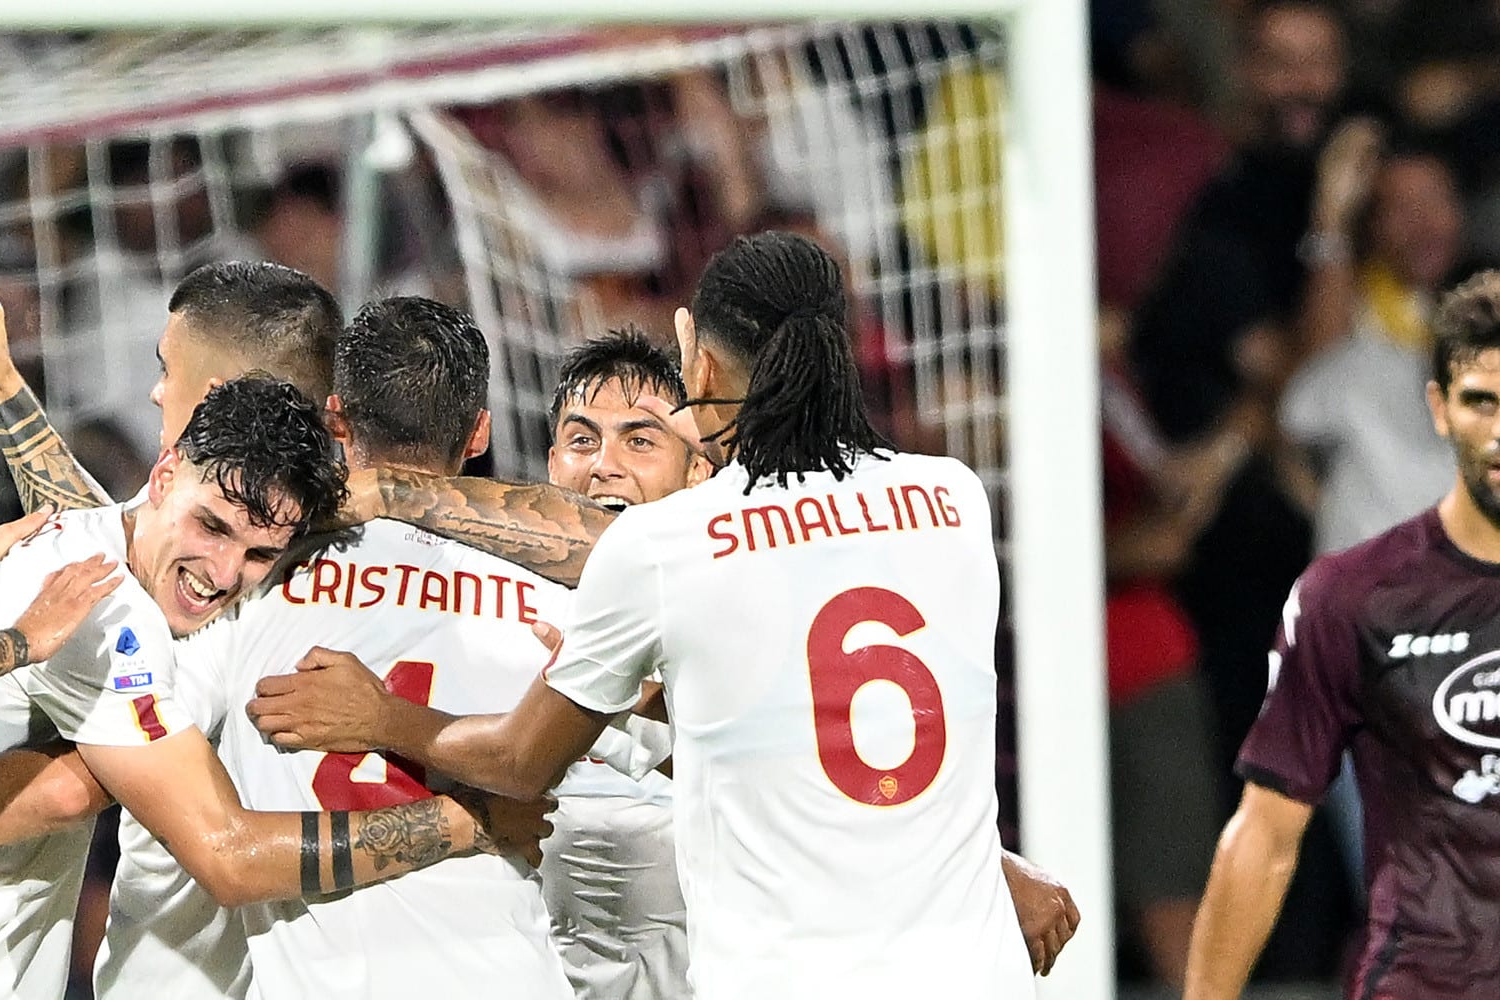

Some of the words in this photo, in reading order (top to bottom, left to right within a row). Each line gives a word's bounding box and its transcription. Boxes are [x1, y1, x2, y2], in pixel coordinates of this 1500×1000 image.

[707, 485, 962, 559] SMALLING
[281, 558, 538, 626] CRISTANTE
[807, 586, 946, 807] 6
